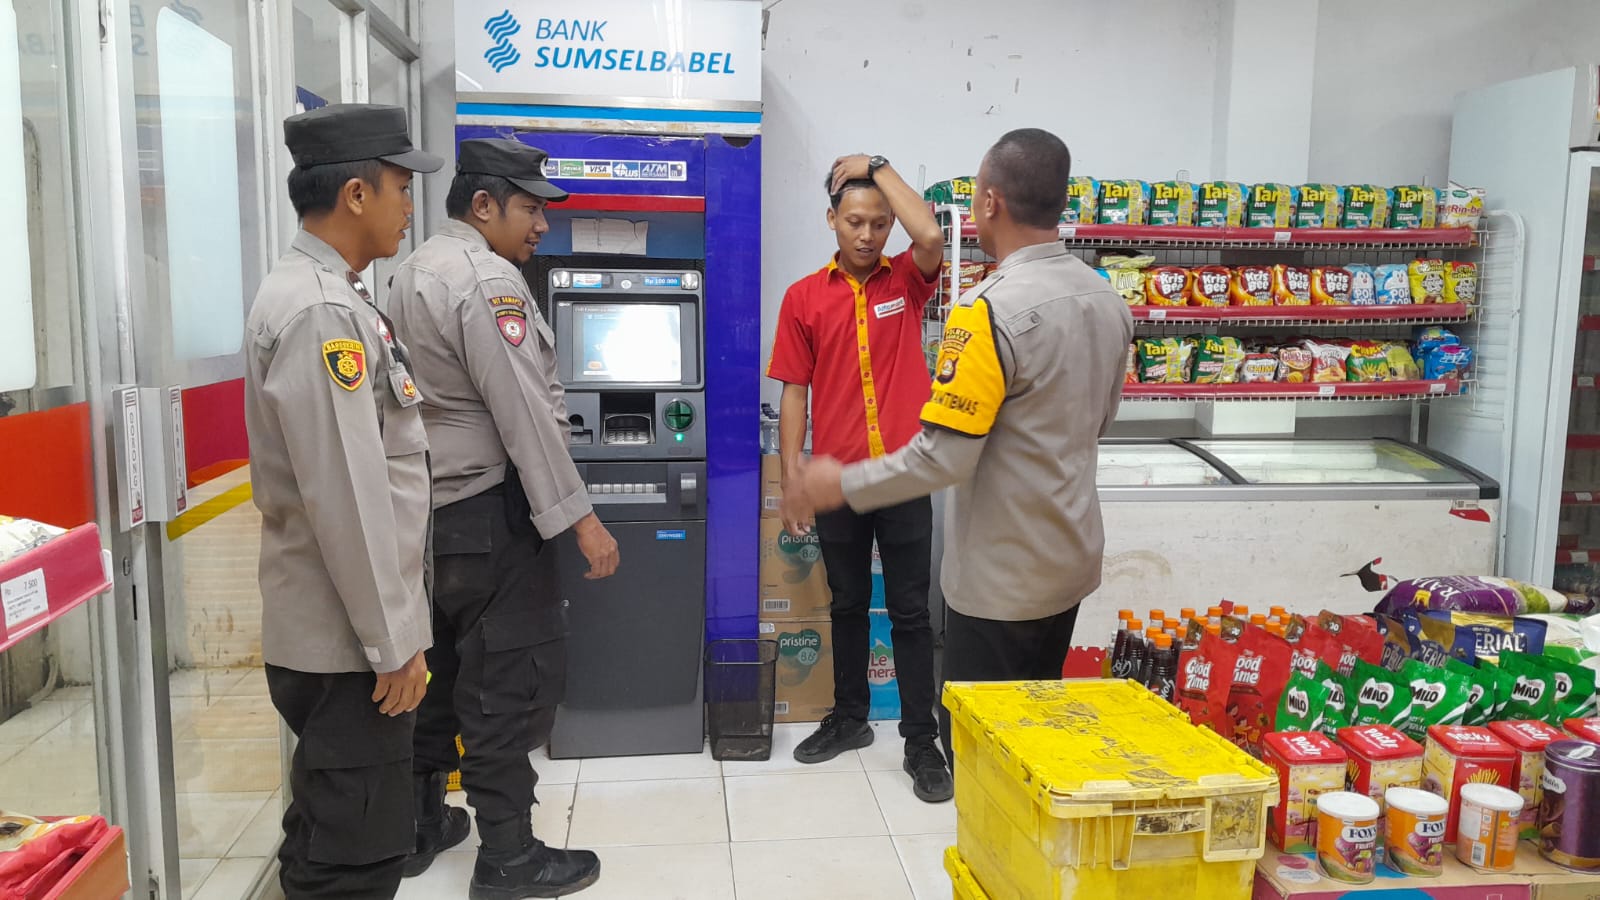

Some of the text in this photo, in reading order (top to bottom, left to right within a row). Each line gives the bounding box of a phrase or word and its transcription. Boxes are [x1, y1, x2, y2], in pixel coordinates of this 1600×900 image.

[535, 18, 607, 41] BANK
[534, 46, 735, 74] SUMSELBABEL
[590, 165, 607, 173] VISA
[621, 168, 638, 178] PLUS
[642, 163, 668, 173] ATM
[1160, 271, 1185, 284] Kris
[1202, 271, 1227, 284] Kris
[1245, 270, 1269, 282] Kris
[1286, 270, 1309, 281] Kris
[1325, 272, 1349, 283] Kris
[1163, 283, 1184, 295] Bee
[1204, 284, 1227, 295] Bee
[1247, 280, 1269, 292] Bee
[1289, 280, 1309, 290] Bee
[1326, 282, 1349, 293] Bee
[780, 636, 818, 649] pristine
[1475, 632, 1524, 653] ERIAL
[870, 652, 887, 667] Le
[1235, 655, 1263, 672] ood
[868, 666, 897, 679] nera
[1186, 656, 1212, 677] Good
[1186, 674, 1209, 691] Time
[1328, 690, 1344, 704] ILO
[1360, 686, 1389, 703] MILO
[1411, 686, 1439, 703] MILO
[1513, 682, 1540, 700] MILO
[1289, 694, 1306, 712] MILO
